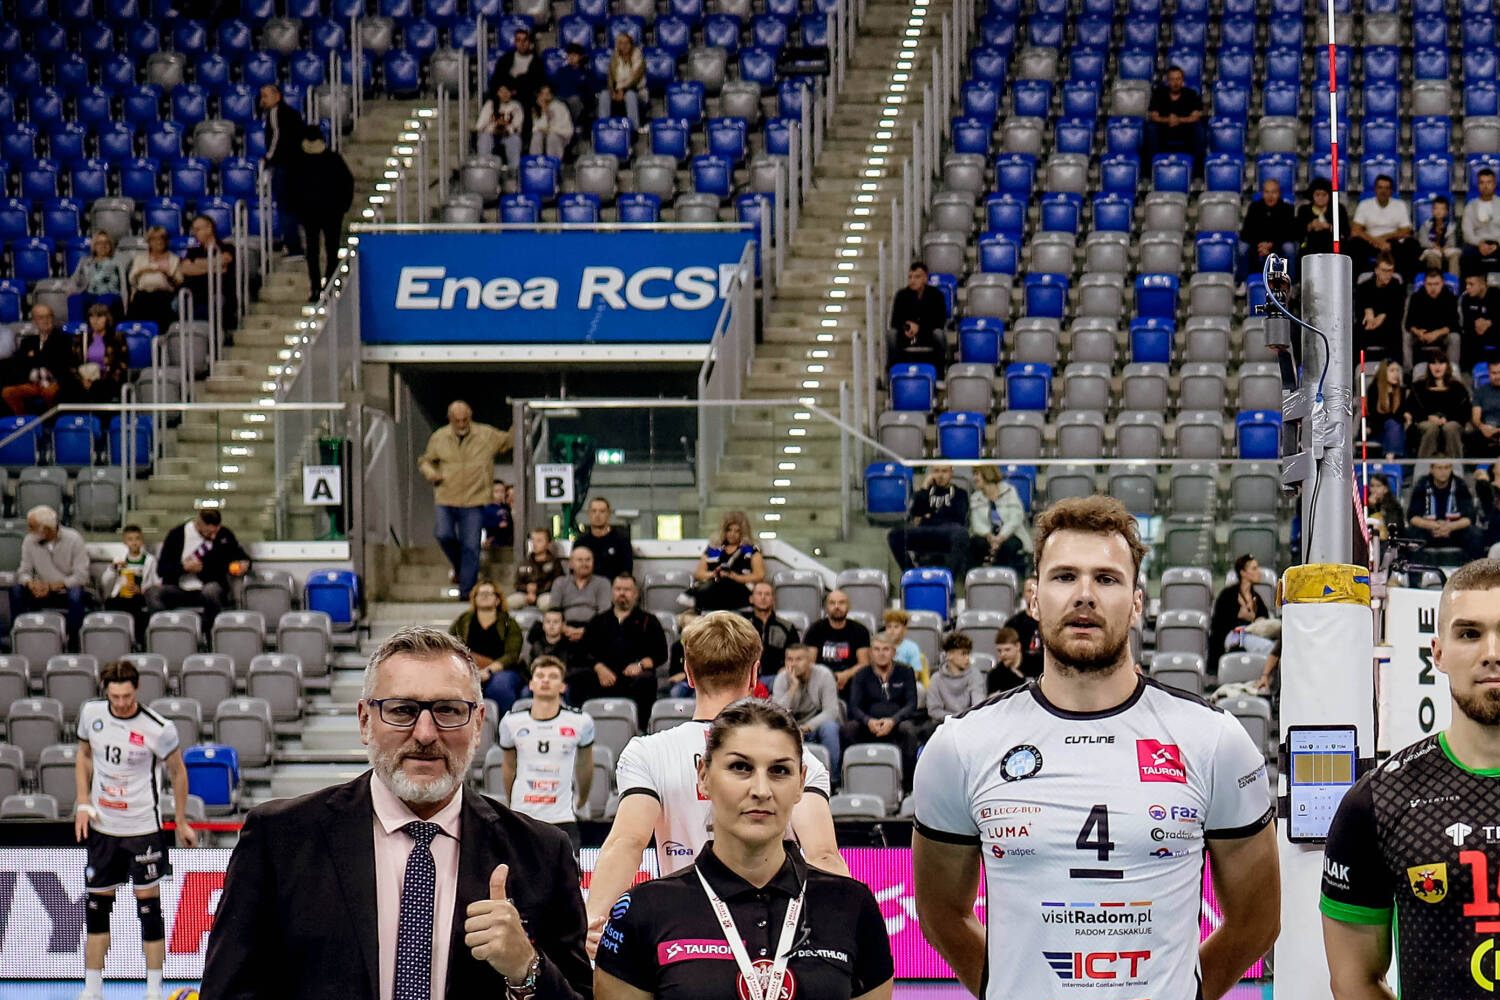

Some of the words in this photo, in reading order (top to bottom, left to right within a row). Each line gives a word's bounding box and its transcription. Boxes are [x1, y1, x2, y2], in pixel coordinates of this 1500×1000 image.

[395, 267, 559, 310] Enea
[578, 266, 718, 310] RCS
[311, 478, 334, 500] A
[545, 476, 565, 498] B
[1064, 735, 1115, 744] CUTLINE
[104, 744, 122, 765] 13
[1141, 766, 1184, 777] TAURON
[987, 826, 1029, 839] LUMA
[1075, 804, 1115, 861] 4
[1007, 847, 1036, 857] radpec
[1041, 909, 1153, 926] visitRadom.pl
[1075, 928, 1106, 936] RADOM
[1108, 927, 1153, 936] ZASKAKUJE
[1074, 950, 1151, 979] ICT
